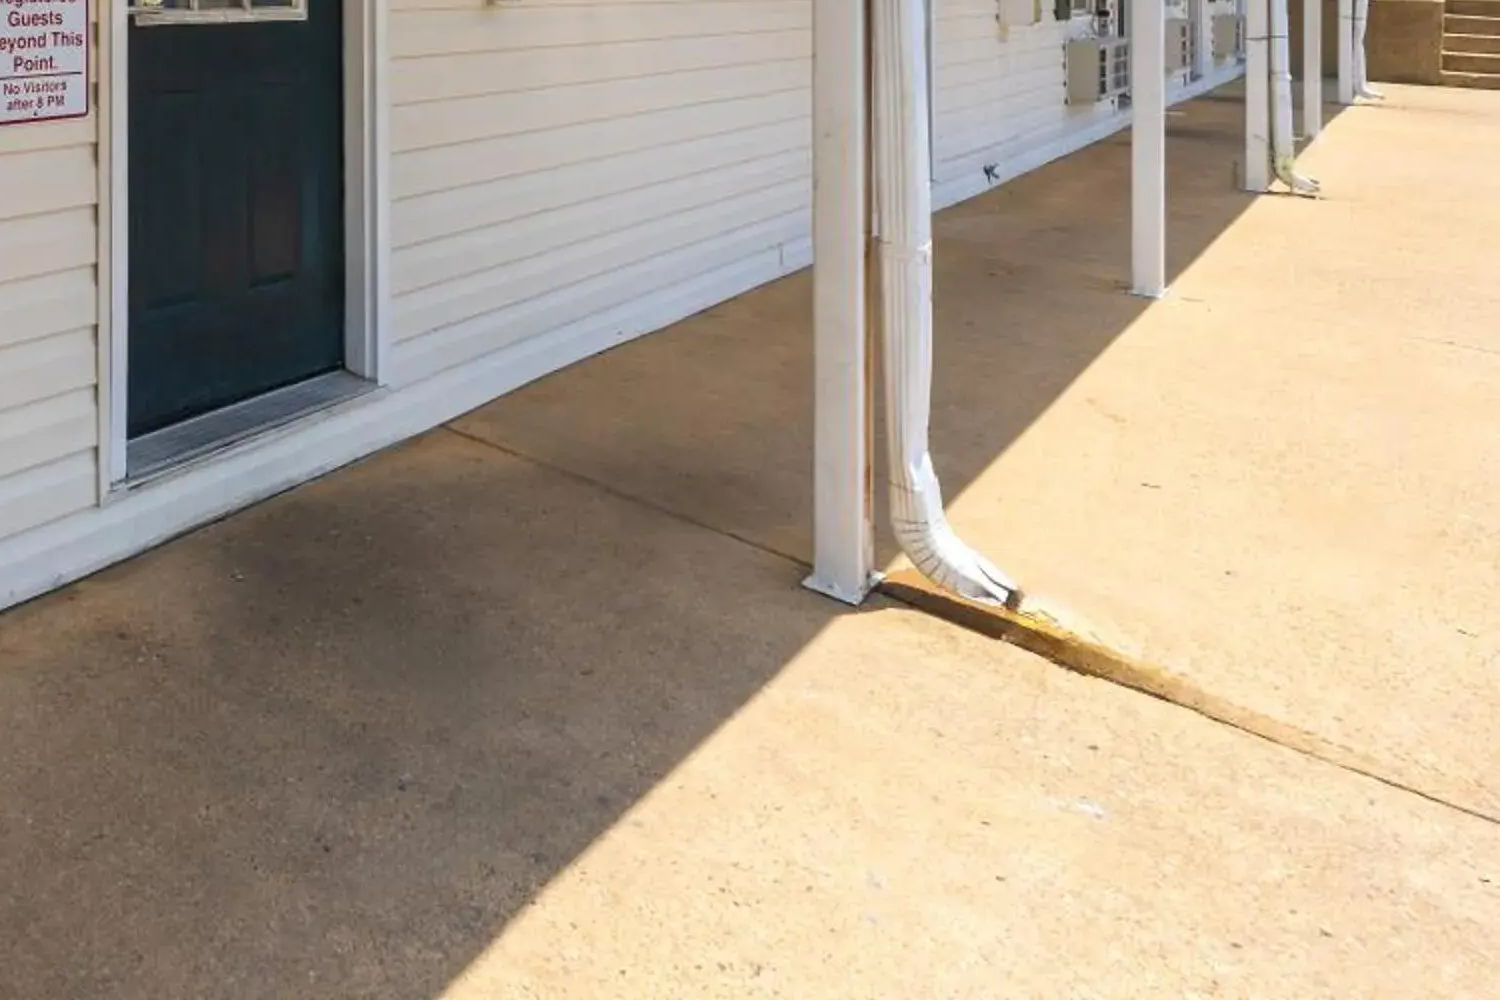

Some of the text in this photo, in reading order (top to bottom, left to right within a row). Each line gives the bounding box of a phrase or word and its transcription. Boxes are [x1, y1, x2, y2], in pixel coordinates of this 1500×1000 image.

[7, 11, 63, 28] Guests
[50, 31, 83, 47] This
[3, 80, 67, 96] No Visitors
[6, 97, 35, 111] after
[47, 95, 65, 107] PM
